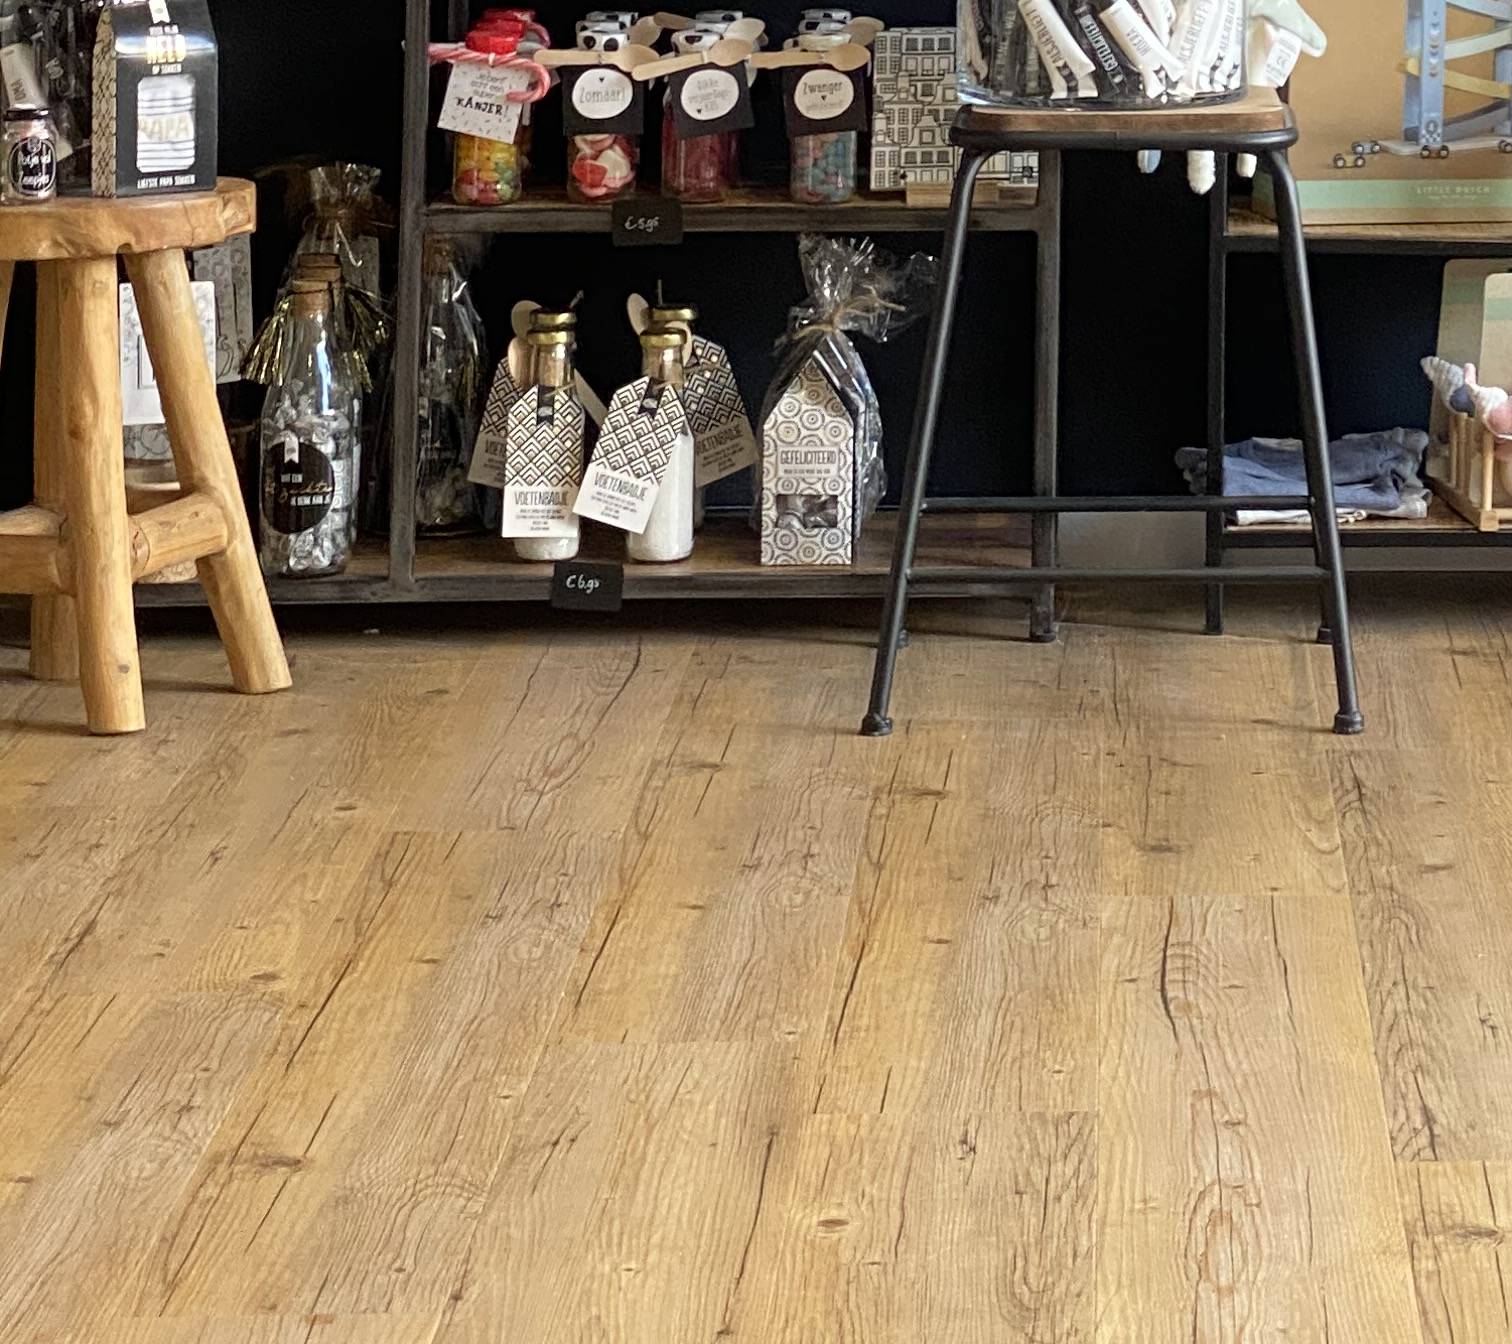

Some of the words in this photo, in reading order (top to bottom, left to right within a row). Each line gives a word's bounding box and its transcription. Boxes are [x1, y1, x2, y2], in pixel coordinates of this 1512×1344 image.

[1415, 184, 1451, 195] LITTLE
[1455, 184, 1492, 195] DUTCH
[780, 450, 838, 467] GEFELICITEERD
[592, 471, 649, 503] VOETENBADJE
[513, 489, 569, 508] VOETENBADJE
